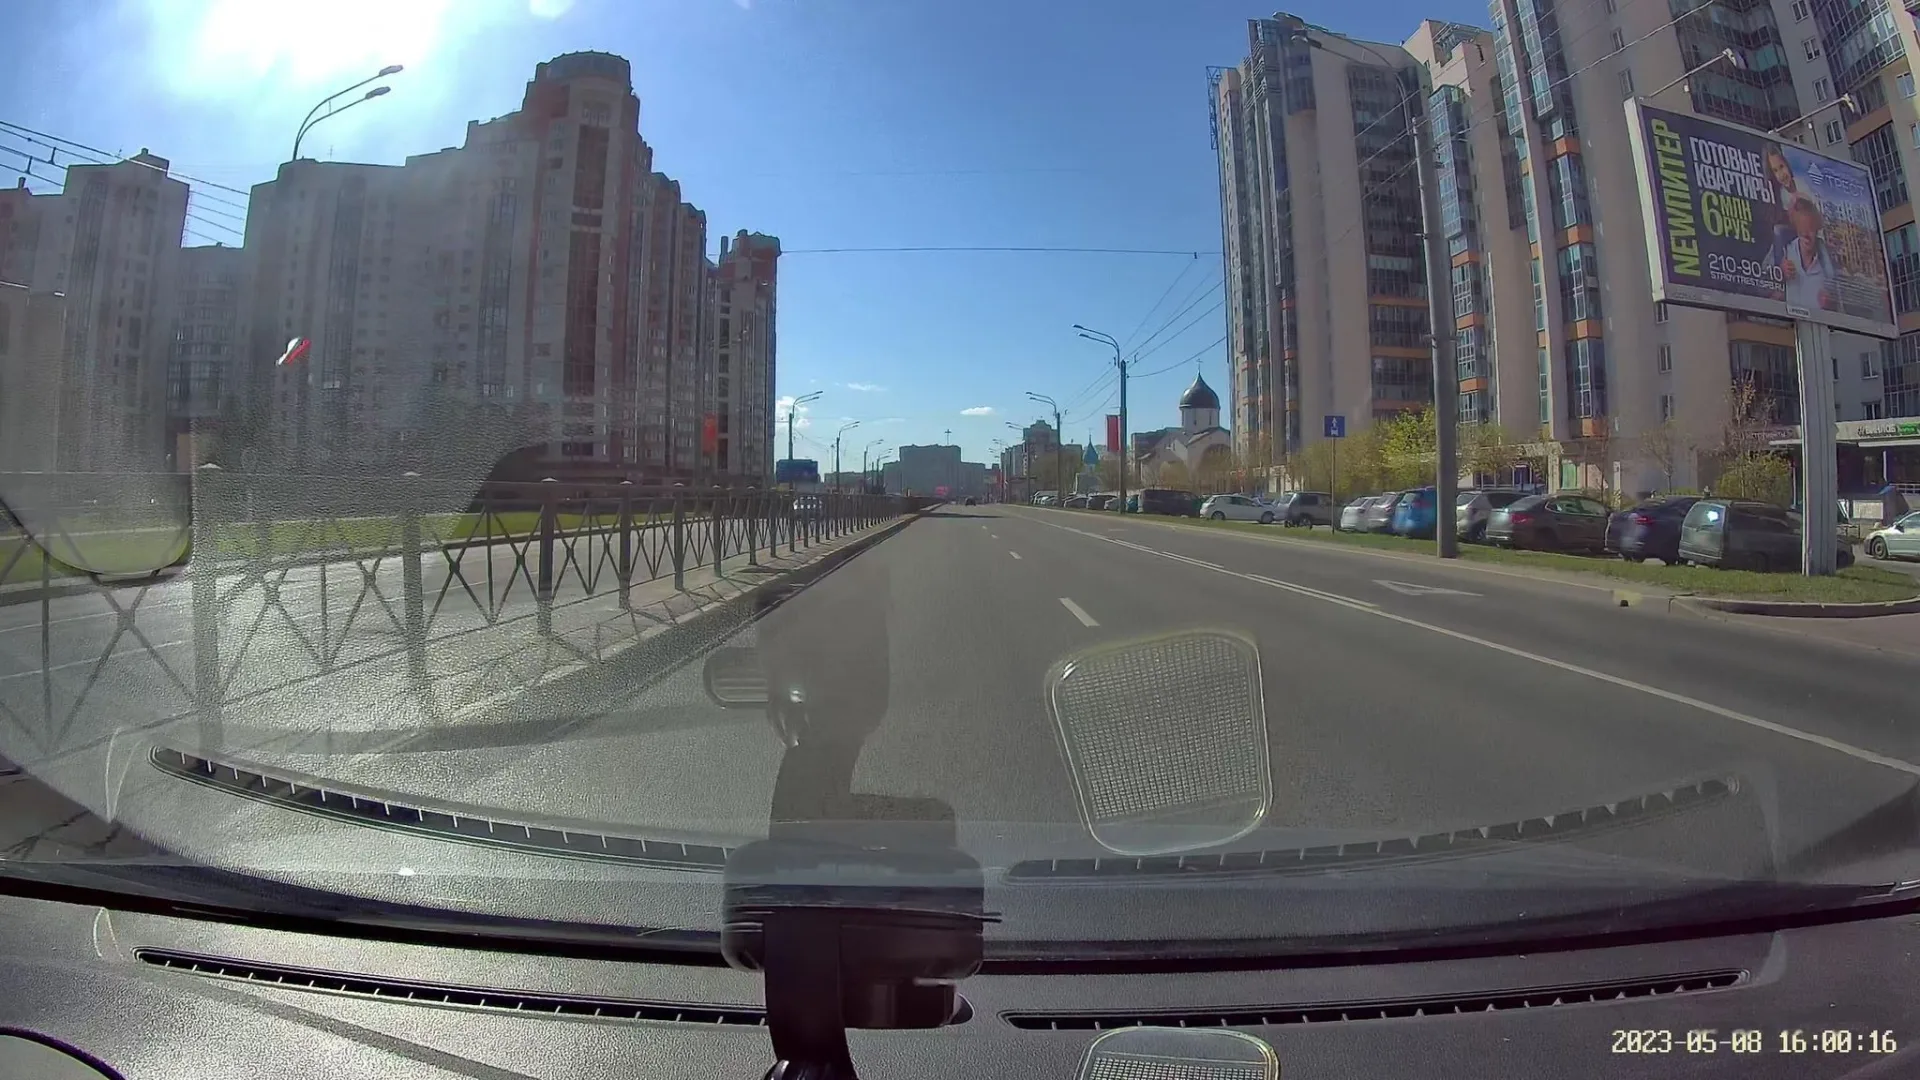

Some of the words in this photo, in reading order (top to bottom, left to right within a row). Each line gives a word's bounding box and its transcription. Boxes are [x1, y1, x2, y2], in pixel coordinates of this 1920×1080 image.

[1689, 136, 1764, 178] ГОТОВЫЕ
[1694, 161, 1776, 205] КВАРТИРЫ
[1701, 190, 1724, 236] 6
[1719, 194, 1752, 222] МЛН
[1723, 216, 1756, 244] РУБ.
[1708, 253, 1783, 282] 210-90-10
